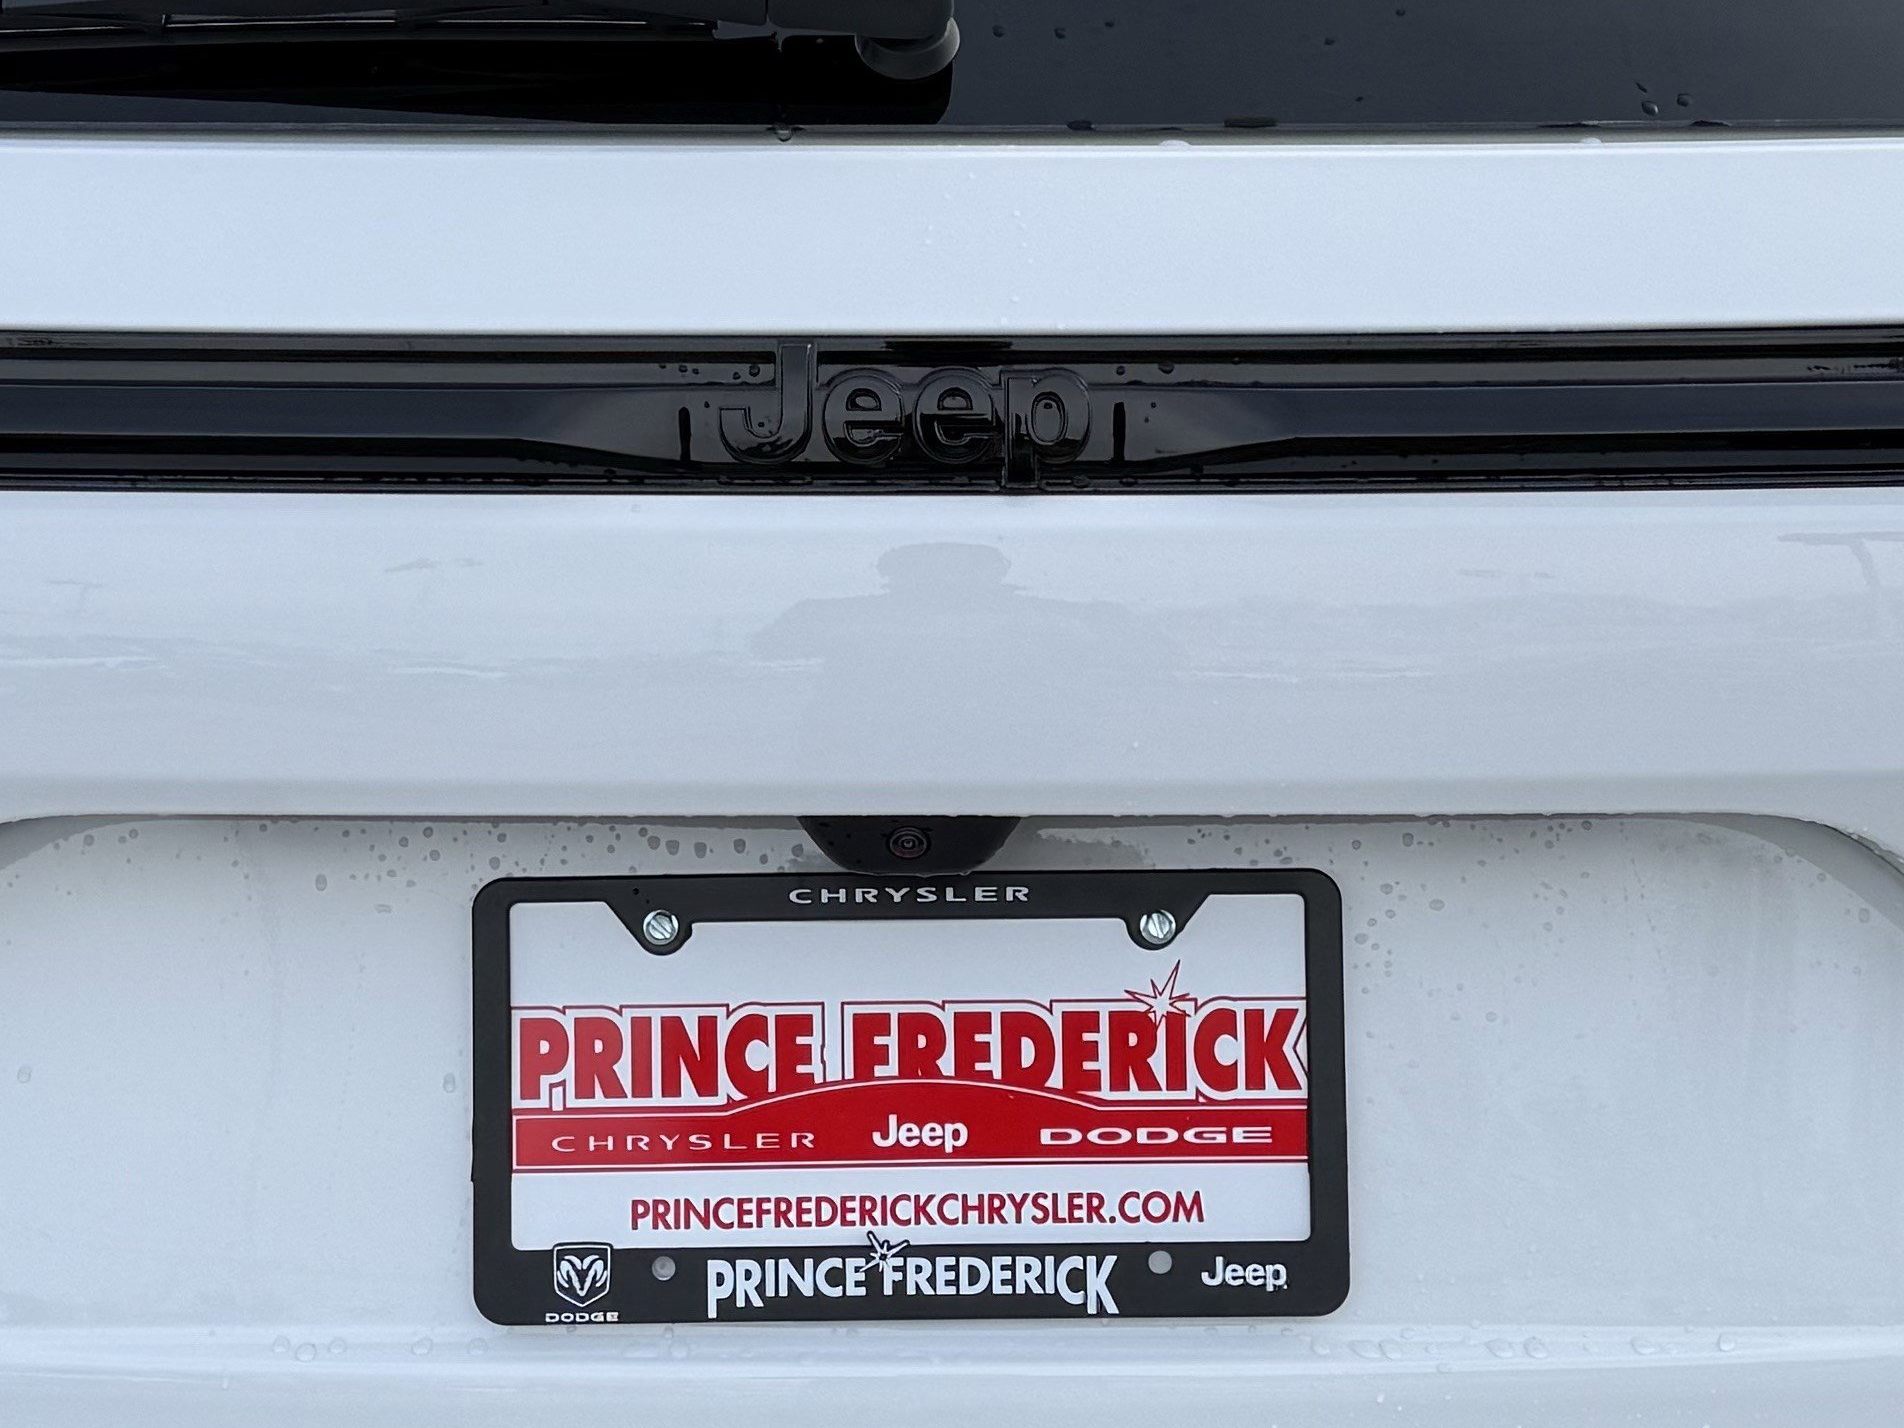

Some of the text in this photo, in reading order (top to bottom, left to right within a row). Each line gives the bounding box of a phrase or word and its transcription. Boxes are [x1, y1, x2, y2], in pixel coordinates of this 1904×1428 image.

[718, 342, 1093, 489] Jeep
[788, 886, 1030, 905] CHRYSLER
[518, 1006, 1304, 1101] PRINCE FREDERICK
[551, 1114, 1273, 1154] CHRYSLER Jeep DODGE
[630, 1190, 1205, 1231] PRINCEFREDERICKCHRYSLER.COM
[706, 1254, 1120, 1319] PRINCE FREDERICK
[1200, 1256, 1289, 1291] Jeep
[545, 1311, 620, 1322] DODGE
